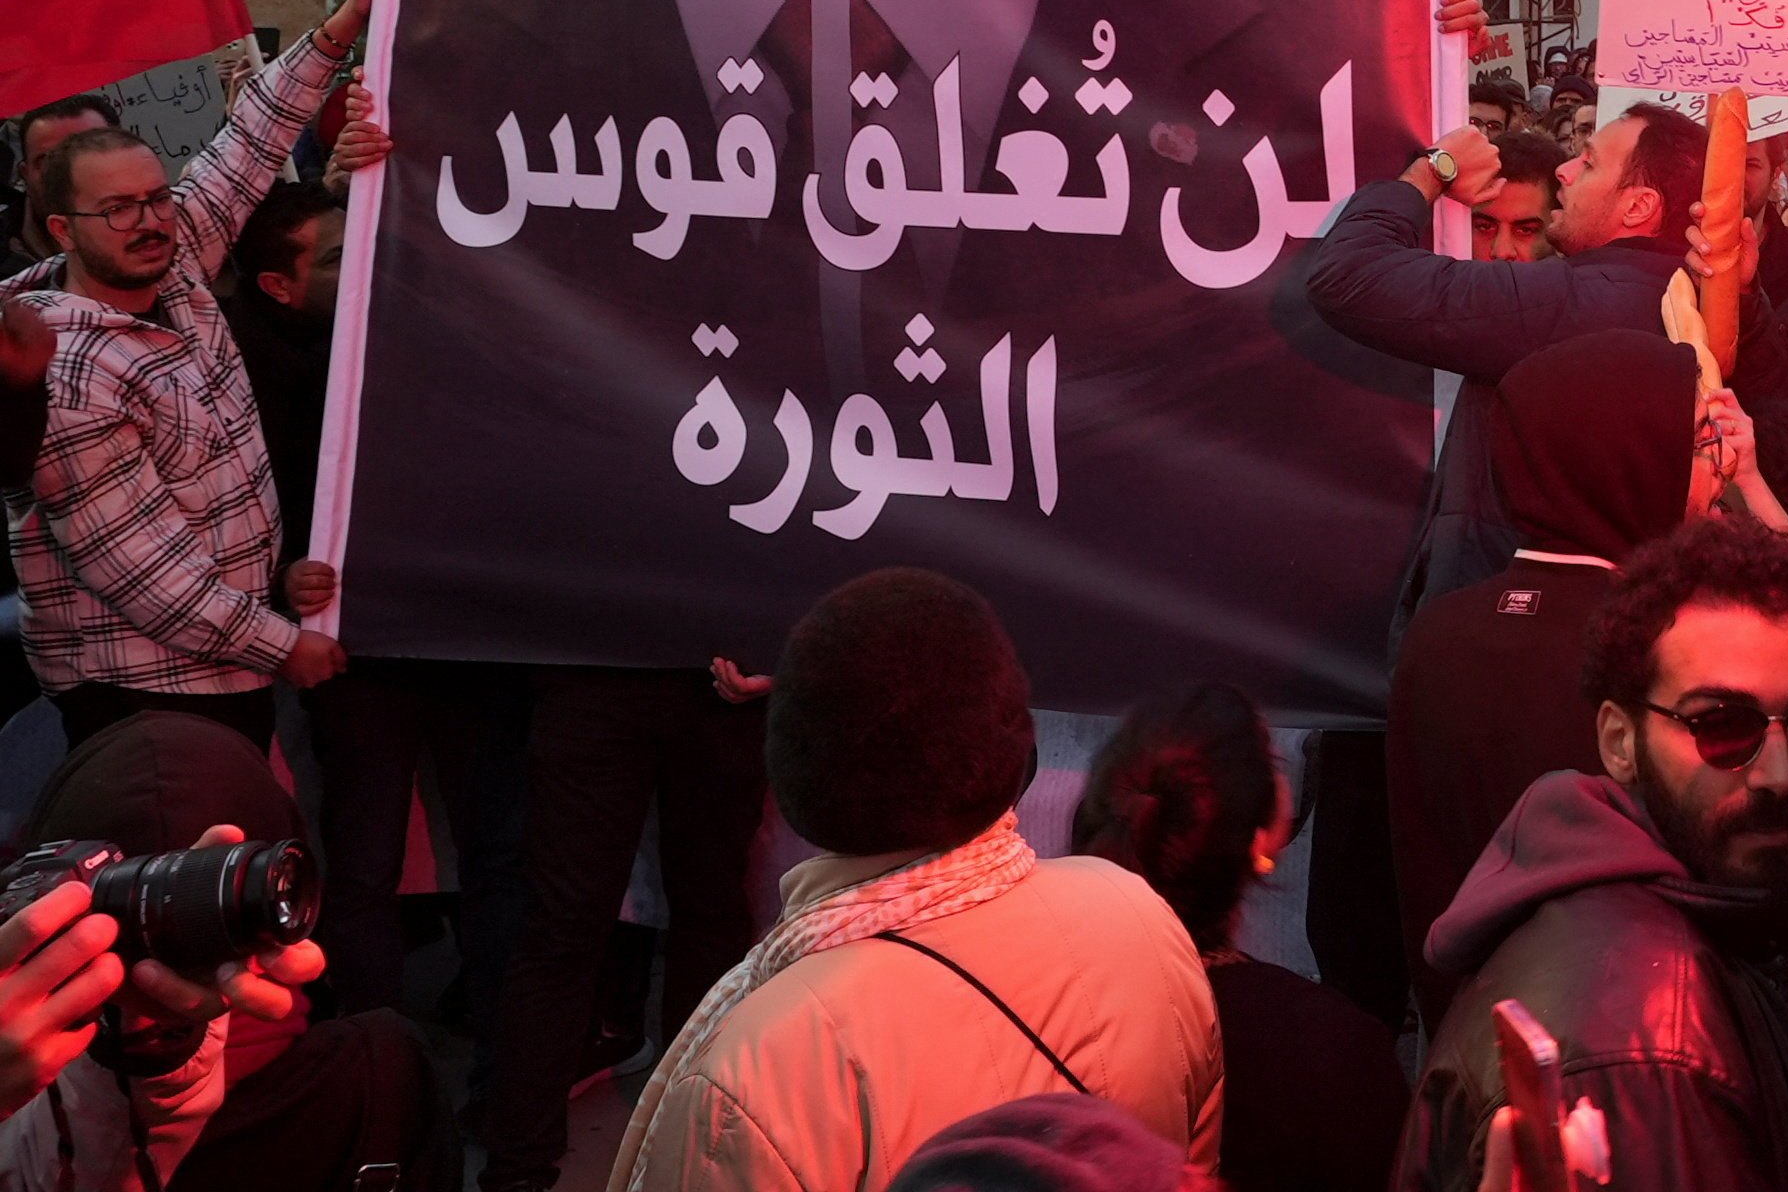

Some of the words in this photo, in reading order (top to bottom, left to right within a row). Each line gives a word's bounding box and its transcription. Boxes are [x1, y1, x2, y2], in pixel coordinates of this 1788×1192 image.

[435, 56, 779, 262] قوس
[1159, 59, 1355, 290] لن
[671, 312, 1060, 541] الثورة
